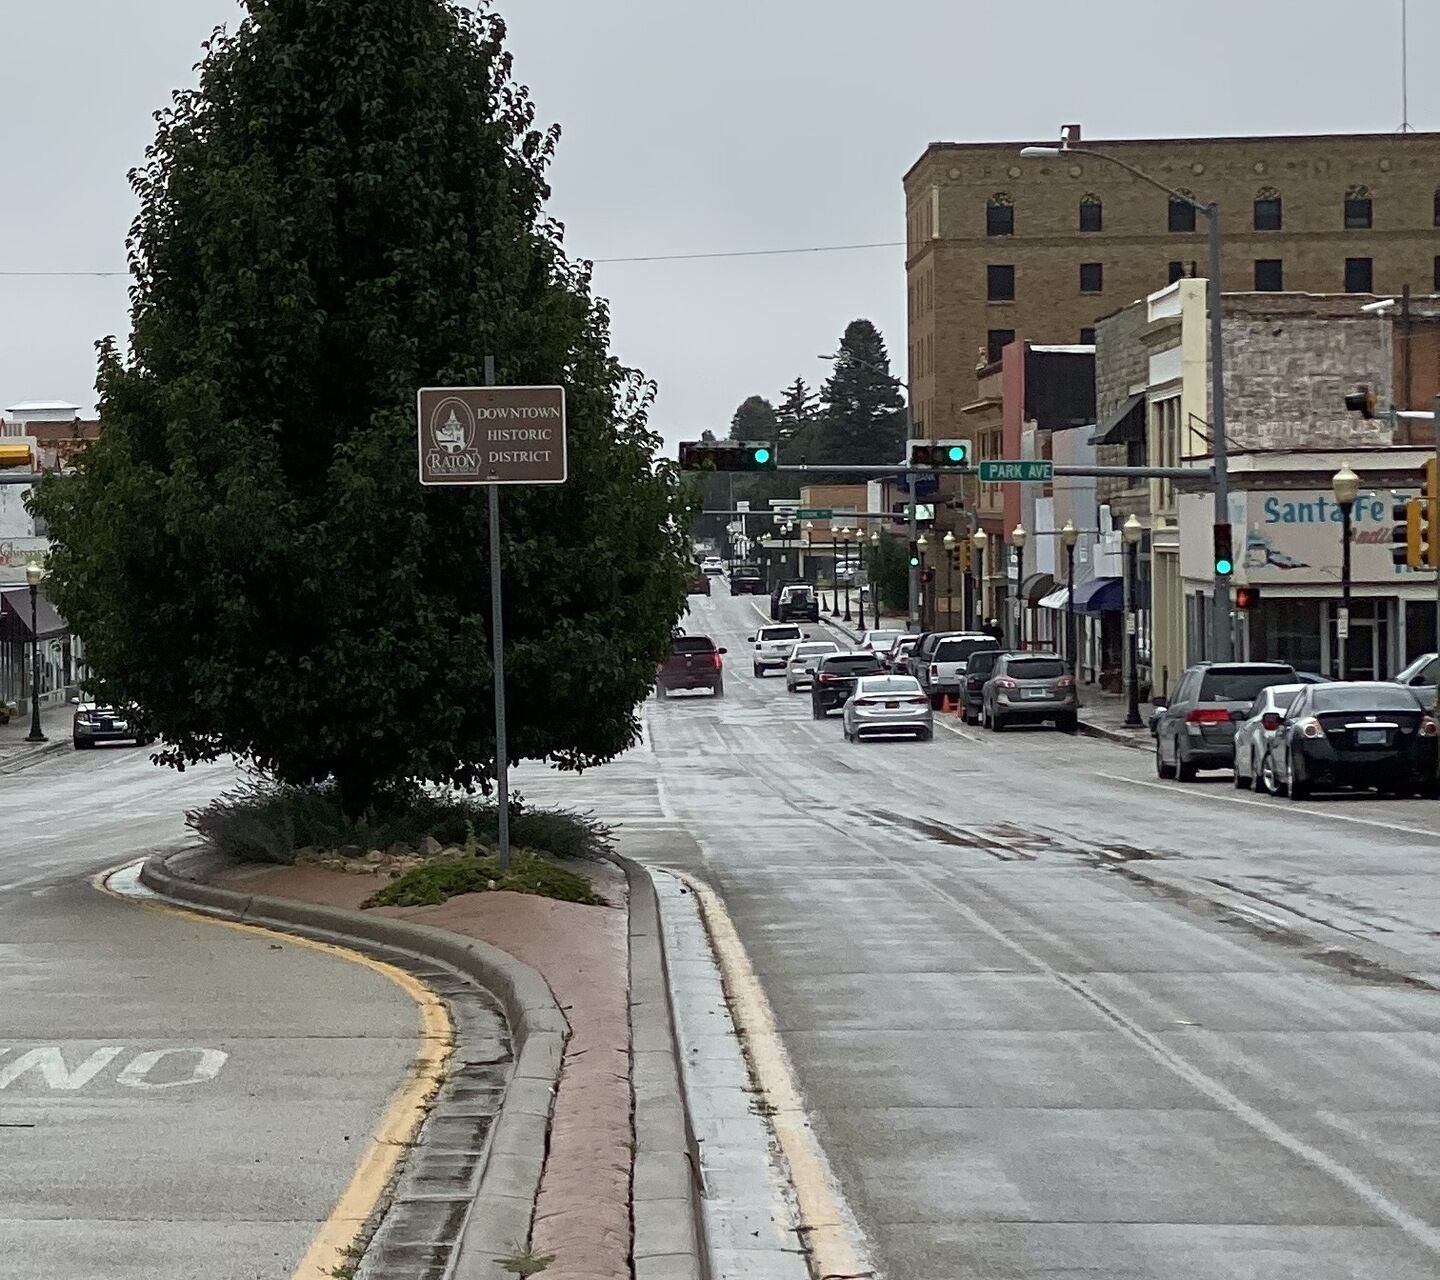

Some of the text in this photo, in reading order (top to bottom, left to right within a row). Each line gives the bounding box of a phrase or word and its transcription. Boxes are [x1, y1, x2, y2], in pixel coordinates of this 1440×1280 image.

[478, 407, 560, 420] DOWNTOWN
[487, 428, 553, 441] HISTORIC
[432, 453, 476, 468] RATON
[488, 450, 552, 463] DISTRICT
[989, 464, 1051, 479] PARK AVE
[1265, 495, 1384, 524] Santa Fe
